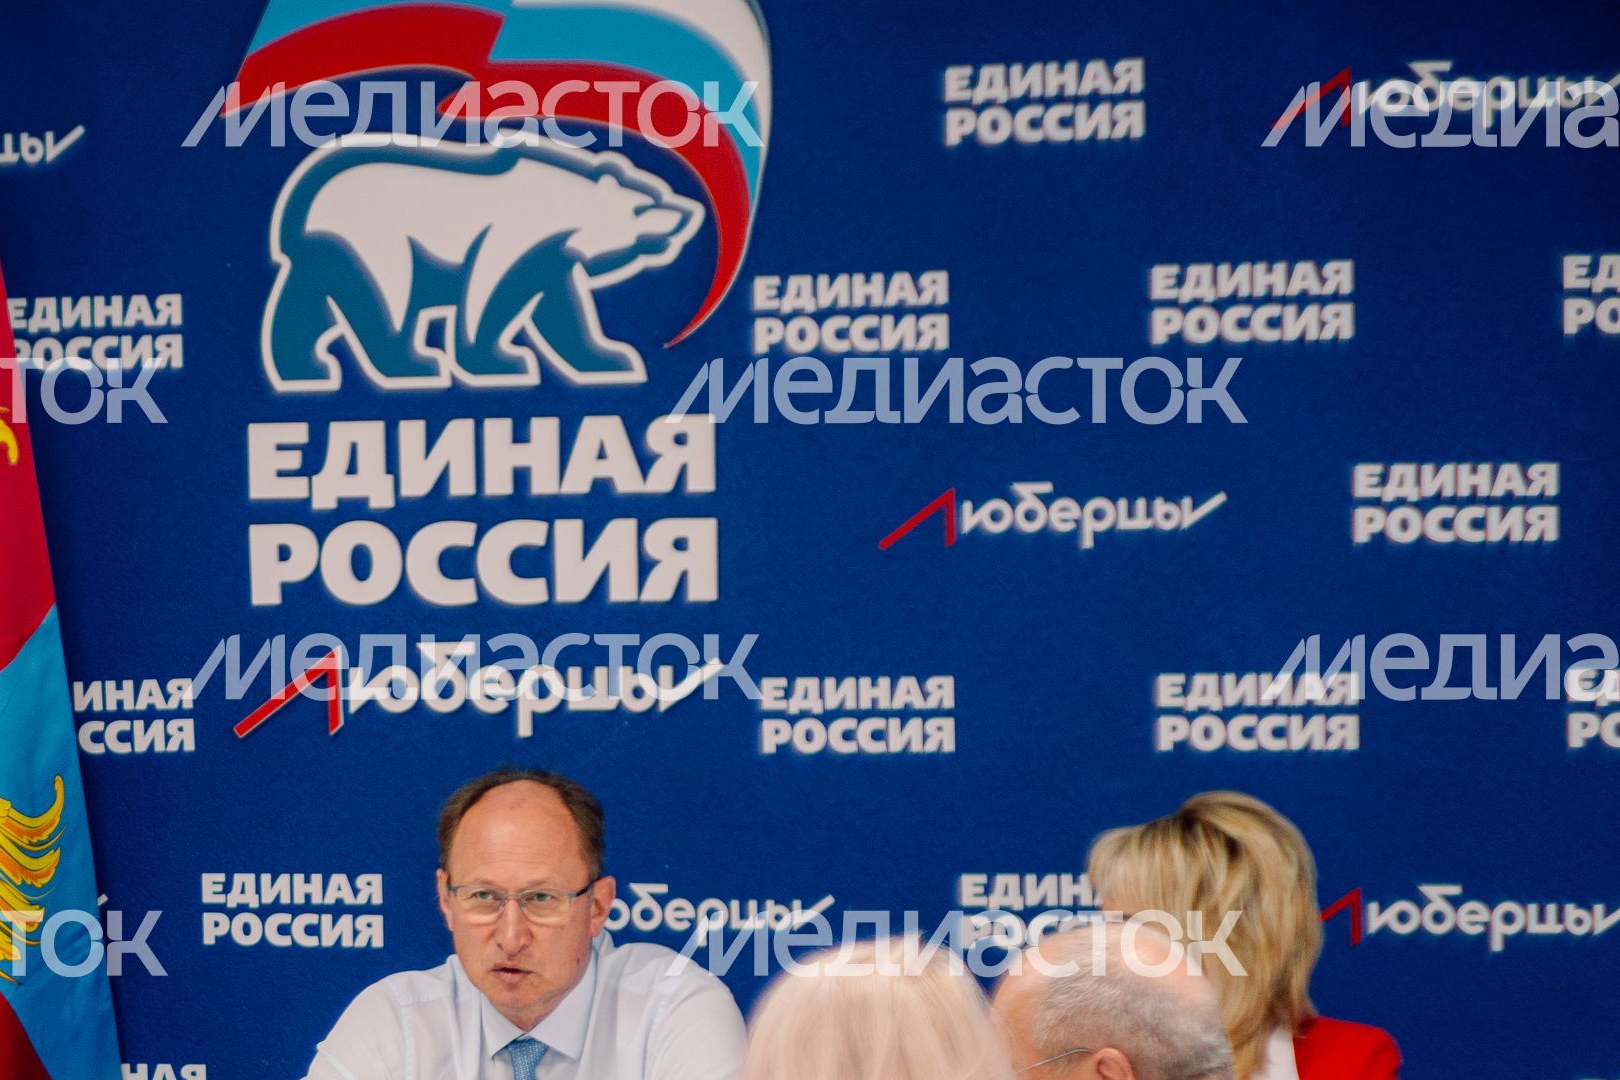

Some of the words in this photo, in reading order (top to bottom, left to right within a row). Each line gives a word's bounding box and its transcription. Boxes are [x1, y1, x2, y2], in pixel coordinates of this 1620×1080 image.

[943, 58, 1146, 103] ЕДИНАЯ
[943, 100, 1146, 146] РОССИЯ
[752, 270, 949, 312] ЕДИНАЯ
[1150, 259, 1355, 302] ЕДИНАЯ
[7, 293, 183, 333] ЕДИНАЯ
[753, 312, 949, 354] РОССИЯ
[1150, 302, 1355, 346] РОССИЯ
[15, 333, 183, 371] РОССИЯ
[247, 413, 716, 511] ЕДИНАЯ
[1352, 462, 1560, 499] ЕДИНАЯ
[877, 481, 1228, 550] Люберцы
[1352, 504, 1560, 545] РОССИЯ
[248, 517, 720, 606] РОССИЯ
[73, 678, 194, 711] ИНАЯ
[233, 641, 728, 738] Люберцы
[760, 675, 956, 713] ЕДИНАЯ
[1157, 673, 1359, 711] ЕДИНАЯ
[78, 718, 196, 754] ССИЯ
[760, 716, 956, 755] РОССИЯ
[1157, 714, 1359, 753] РОССИЯ
[201, 873, 384, 907] ЕДИНАЯ
[961, 873, 1103, 910] ЕДИН
[201, 912, 384, 948] РОССИЯ
